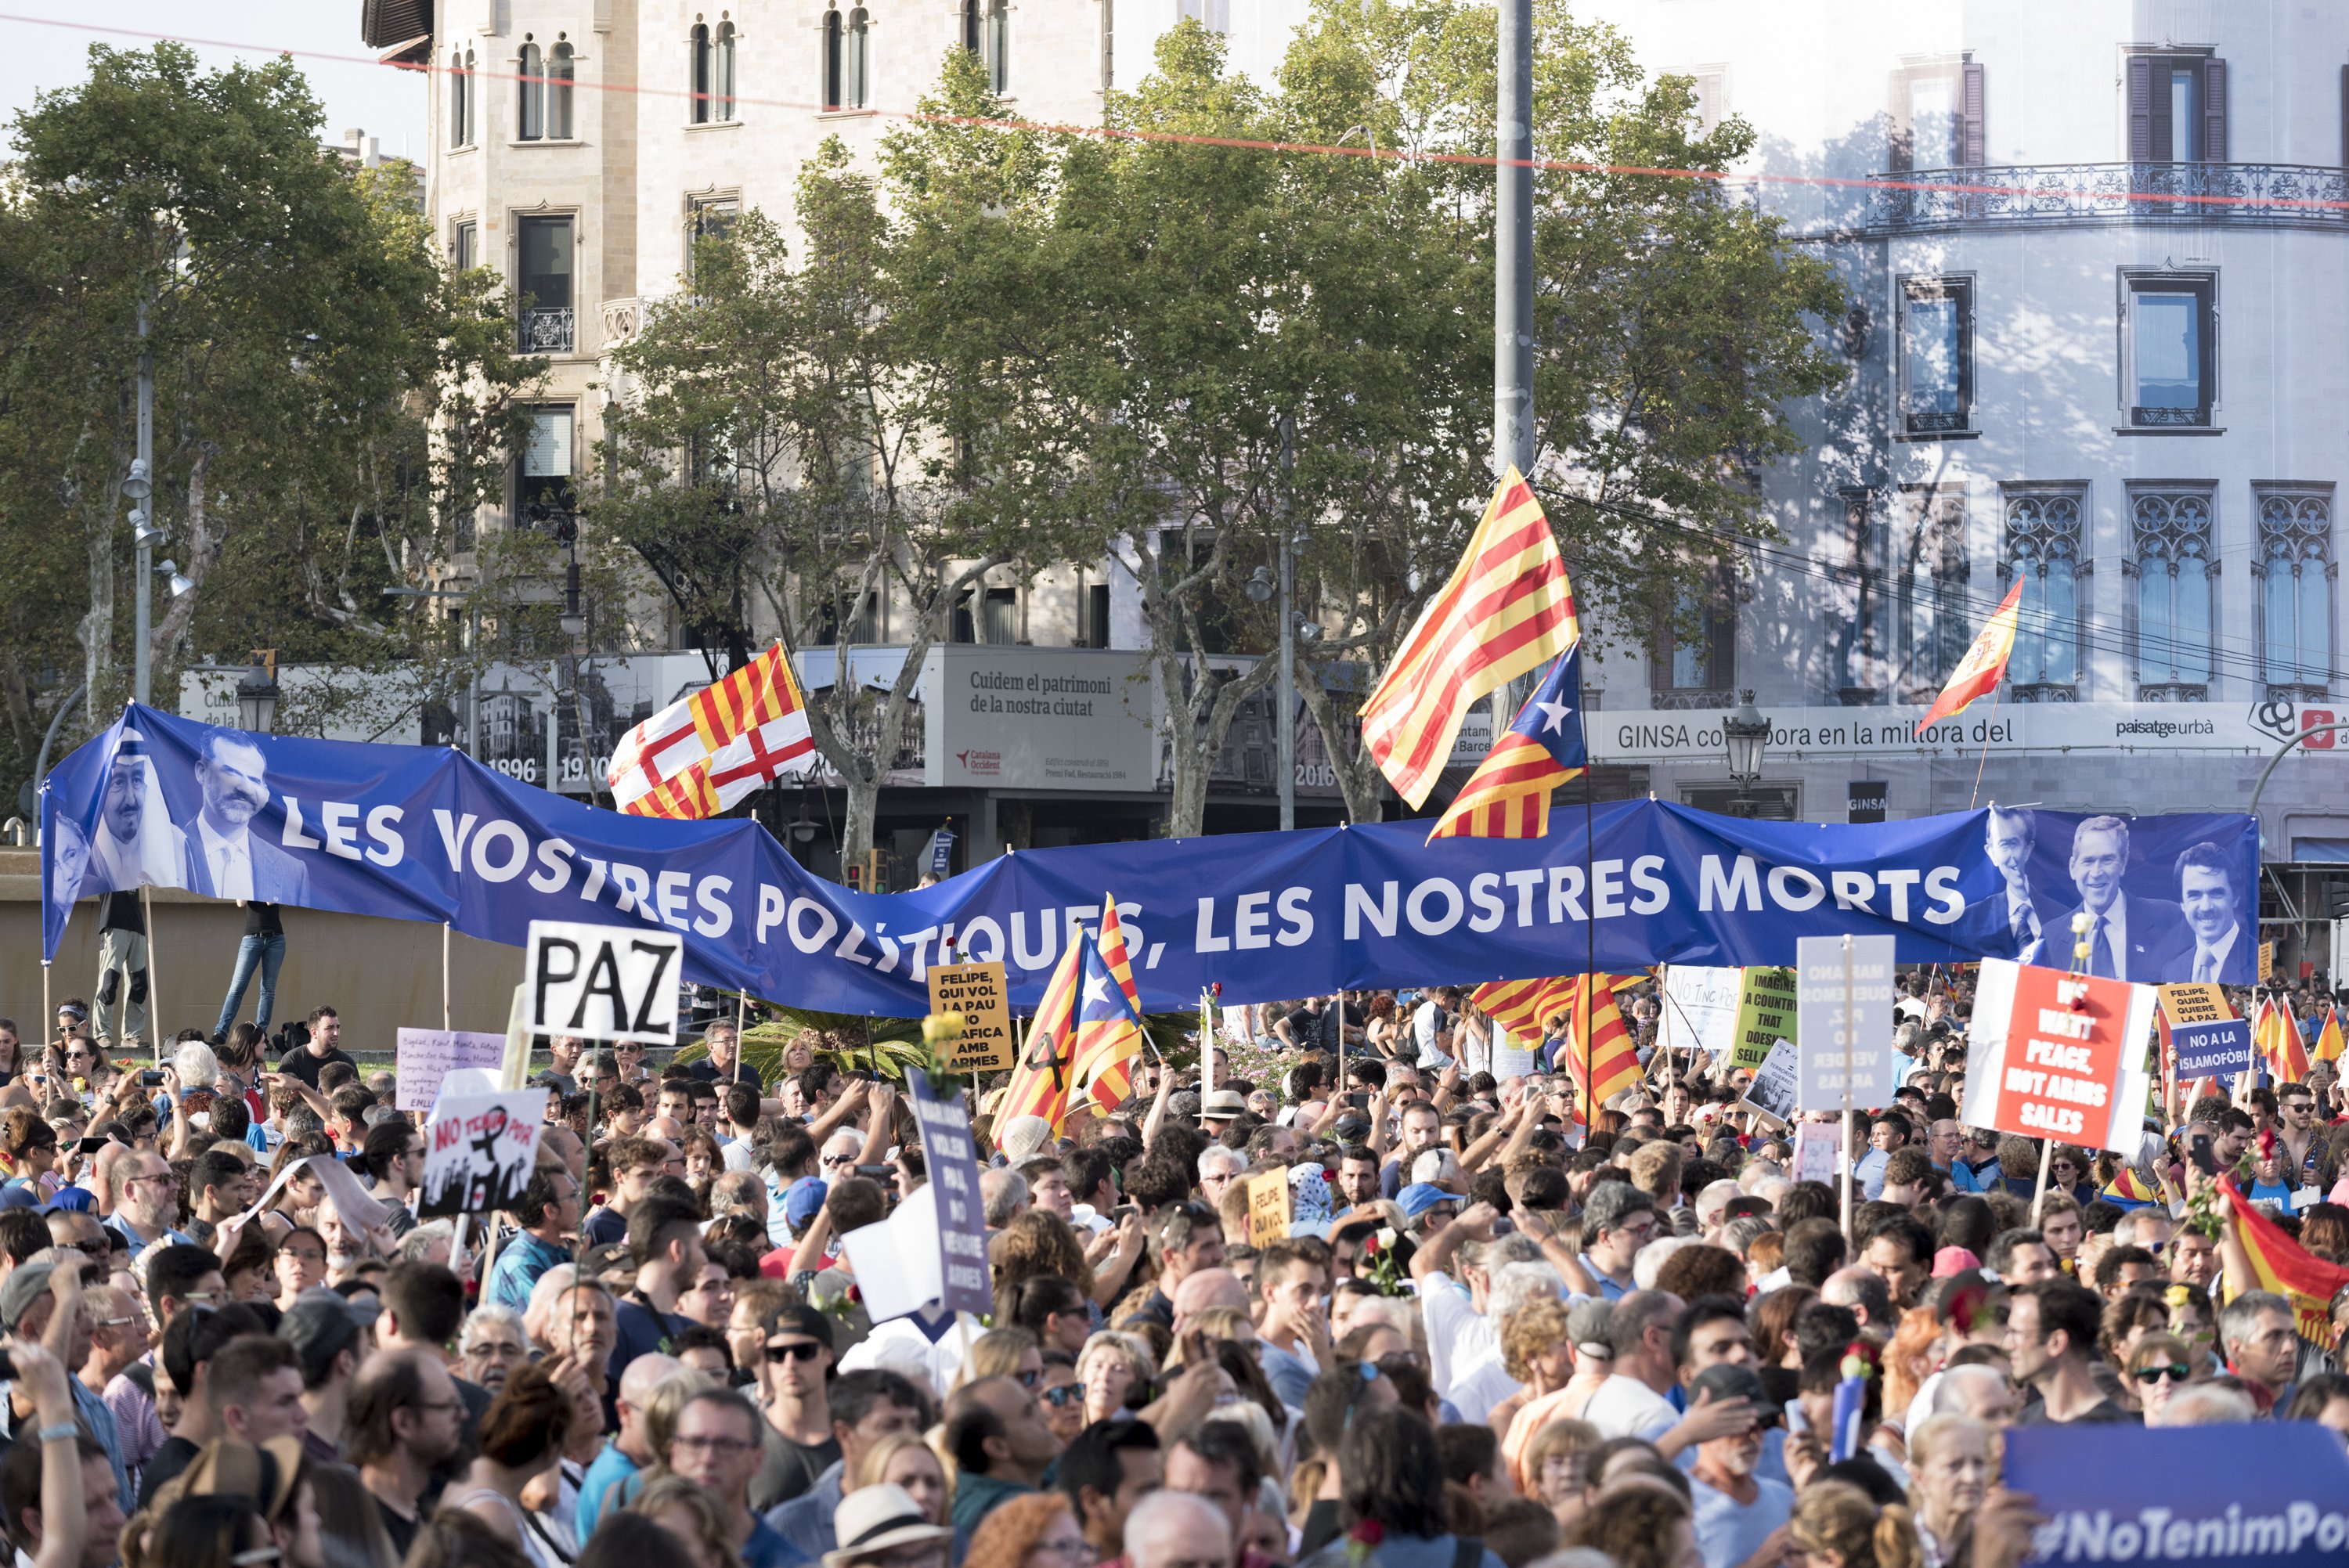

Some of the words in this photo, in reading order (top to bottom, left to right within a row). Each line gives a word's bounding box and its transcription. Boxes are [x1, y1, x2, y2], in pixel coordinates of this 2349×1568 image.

[970, 671, 1024, 690] Cuidem
[1027, 673, 1040, 691] el
[1042, 675, 1112, 695] patrimoni
[970, 694, 987, 712] de
[990, 695, 1003, 712] la
[1006, 697, 1051, 715] nostra
[1053, 697, 1093, 716] ciutat
[1618, 725, 1690, 748] GINSA
[1819, 727, 1845, 744] en
[1854, 722, 1873, 744] la
[1882, 720, 1964, 744] millora
[1972, 719, 2013, 743] del
[2116, 719, 2177, 738] paisatge
[2178, 719, 2214, 734] urbà
[971, 750, 1001, 760] Catalana
[1460, 741, 1491, 752] Barce
[971, 760, 1000, 770] Occident
[1295, 764, 1335, 786] 2016
[1849, 798, 1886, 810] GINSA
[282, 795, 405, 867] LES
[433, 809, 733, 939] VOSTRES
[1196, 887, 1315, 953] LES
[1344, 854, 1671, 940] NOSTRES
[1698, 855, 1966, 925] MORTS
[535, 937, 677, 1035] PAZ
[940, 971, 993, 985] FELIPE,
[1671, 971, 1690, 1000] NO
[1695, 984, 1716, 1003] TINC
[1754, 975, 1796, 993] IMAGINE
[939, 987, 964, 999] QUI
[967, 986, 998, 997] VOL
[1745, 993, 1752, 1004] A
[2170, 987, 2209, 997] FELIPE,
[2177, 997, 2210, 1005] QUIEN
[965, 1000, 995, 1011] PAU
[2178, 1005, 2216, 1015] QUIERE
[1758, 1013, 1783, 1029] THAT
[2038, 1008, 2097, 1040] WANT
[957, 1042, 990, 1054] AMB
[2189, 1034, 2208, 1048] NO
[2210, 1033, 2219, 1045] A
[2221, 1030, 2236, 1044] LA
[949, 1054, 999, 1069] ARMES
[1737, 1048, 1759, 1062] SELL
[2026, 1039, 2094, 1075] PEACE,
[1772, 1072, 1794, 1086] GUERRES
[2004, 1067, 2047, 1096] NOT
[2045, 1075, 2108, 1107] ARMS
[2019, 1102, 2084, 1134] SALES
[435, 1117, 461, 1152] NO
[930, 1132, 969, 1161] VOLEM
[949, 1199, 968, 1224] NO
[941, 1229, 984, 1260] VENDRE
[947, 1263, 983, 1291] ARMES
[2030, 1501, 2349, 1564] #NoTenimPo
